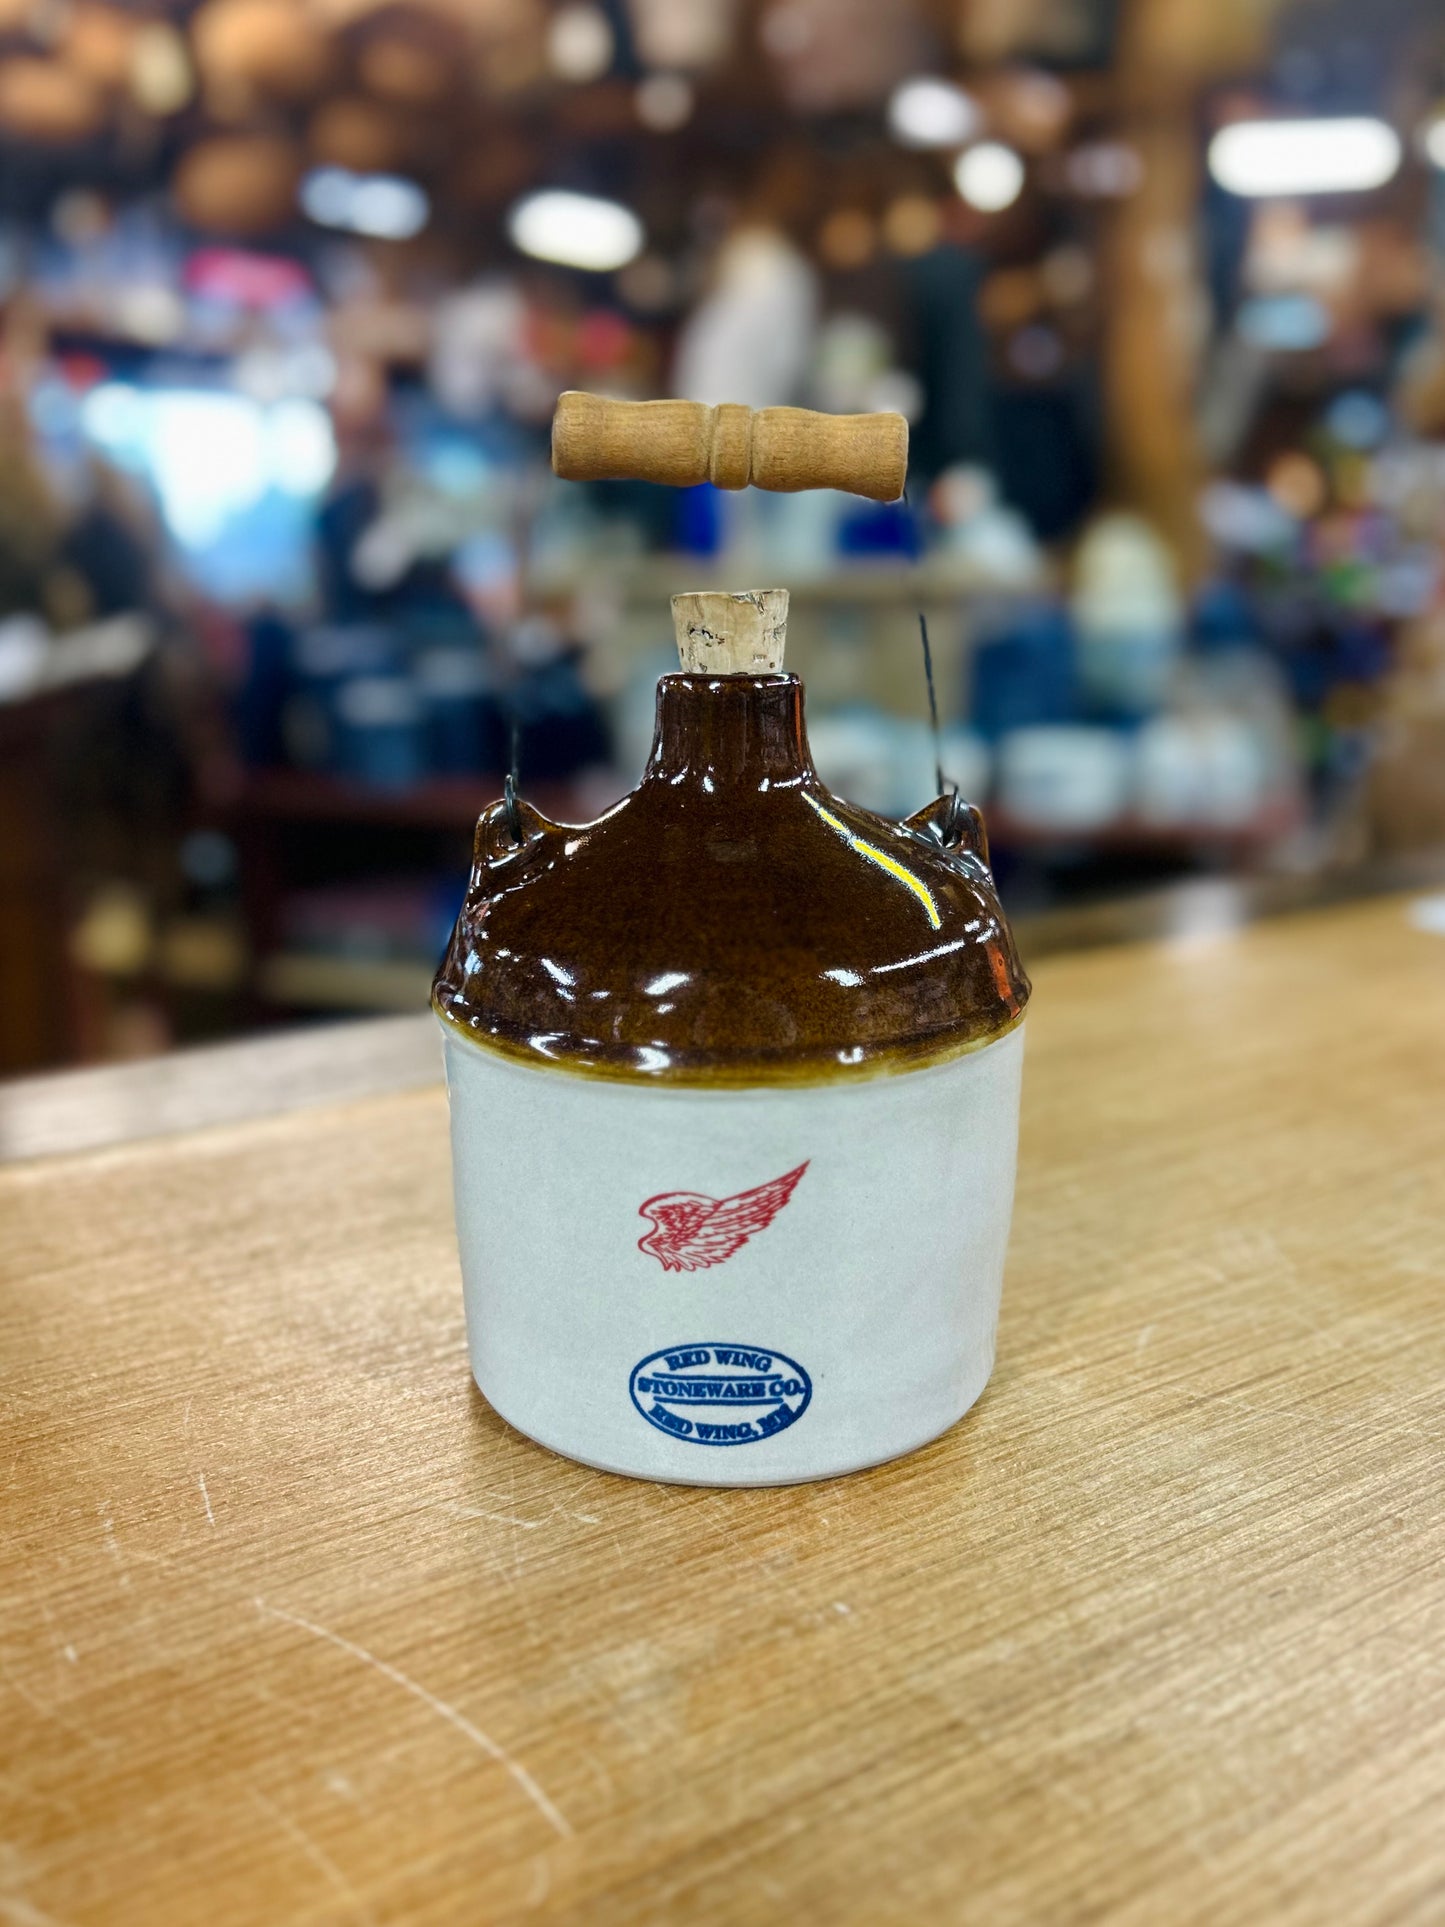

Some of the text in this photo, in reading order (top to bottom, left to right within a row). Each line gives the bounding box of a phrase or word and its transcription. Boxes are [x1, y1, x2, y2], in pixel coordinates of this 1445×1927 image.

[664, 1349, 773, 1373] RED WING
[637, 1376, 766, 1398] STONEWARE
[649, 1403, 693, 1435] RED
